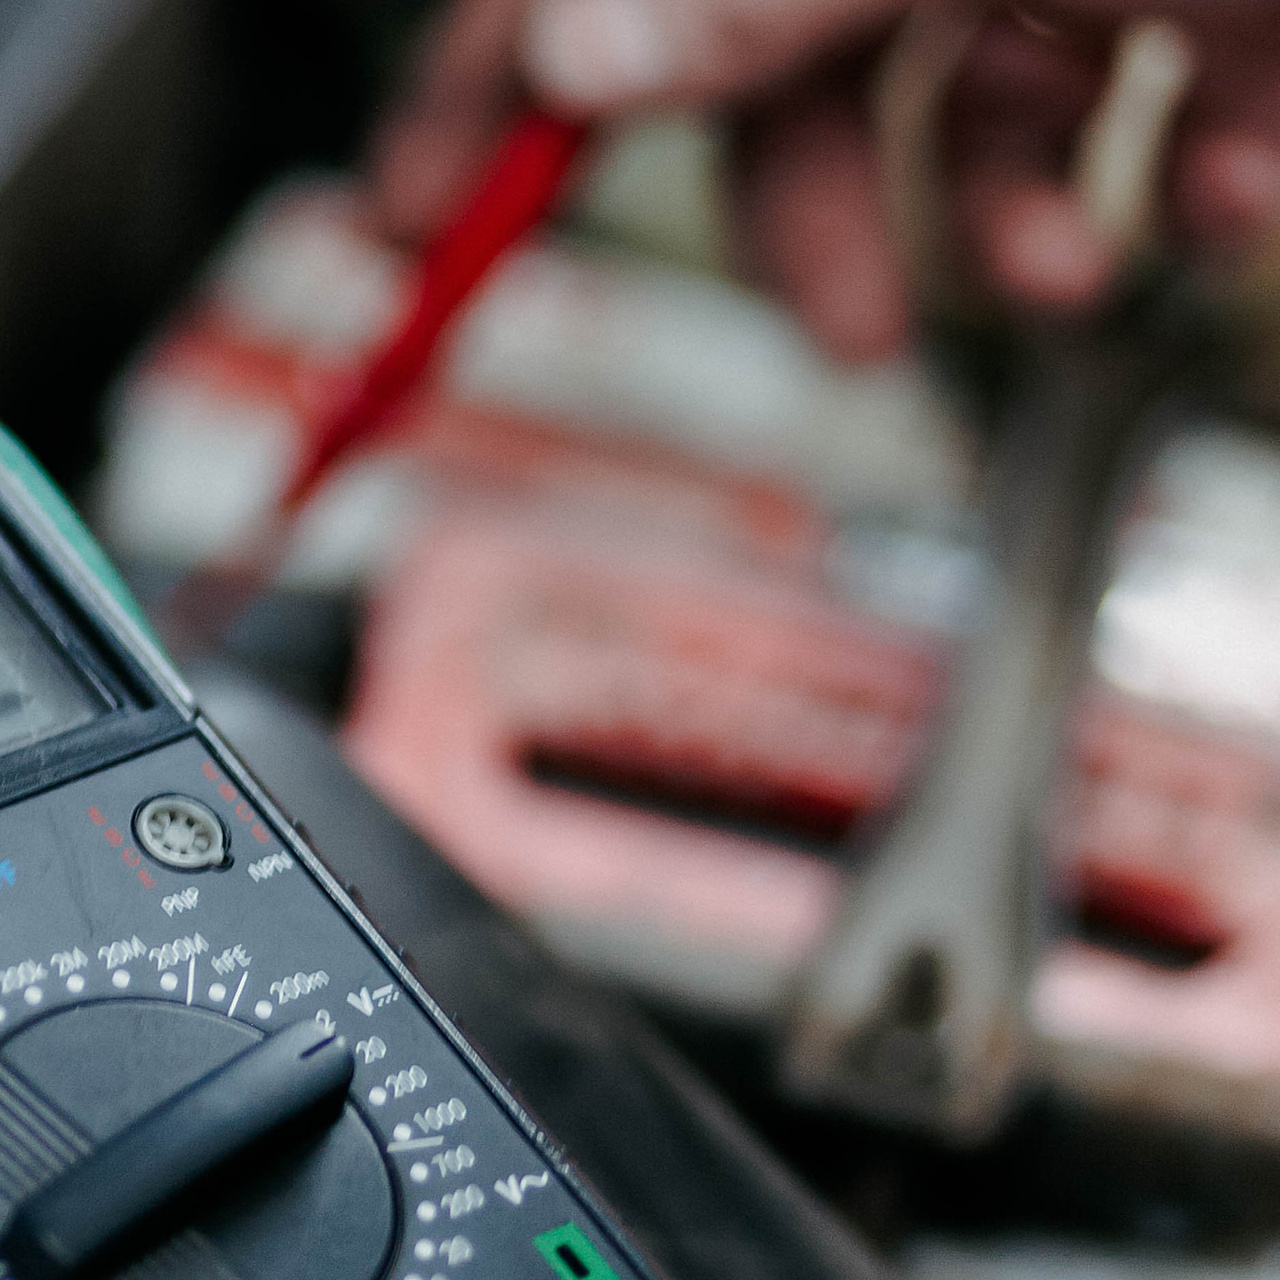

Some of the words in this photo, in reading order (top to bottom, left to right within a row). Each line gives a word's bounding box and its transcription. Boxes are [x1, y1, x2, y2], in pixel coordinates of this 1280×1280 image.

[247, 850, 294, 883] NPN
[161, 886, 199, 917] PNP
[97, 933, 147, 970] 20M
[148, 931, 209, 971] 200M
[270, 969, 330, 1005] 200m
[356, 1035, 387, 1064] 20
[385, 1065, 428, 1099] 200
[413, 1097, 467, 1134] 1000
